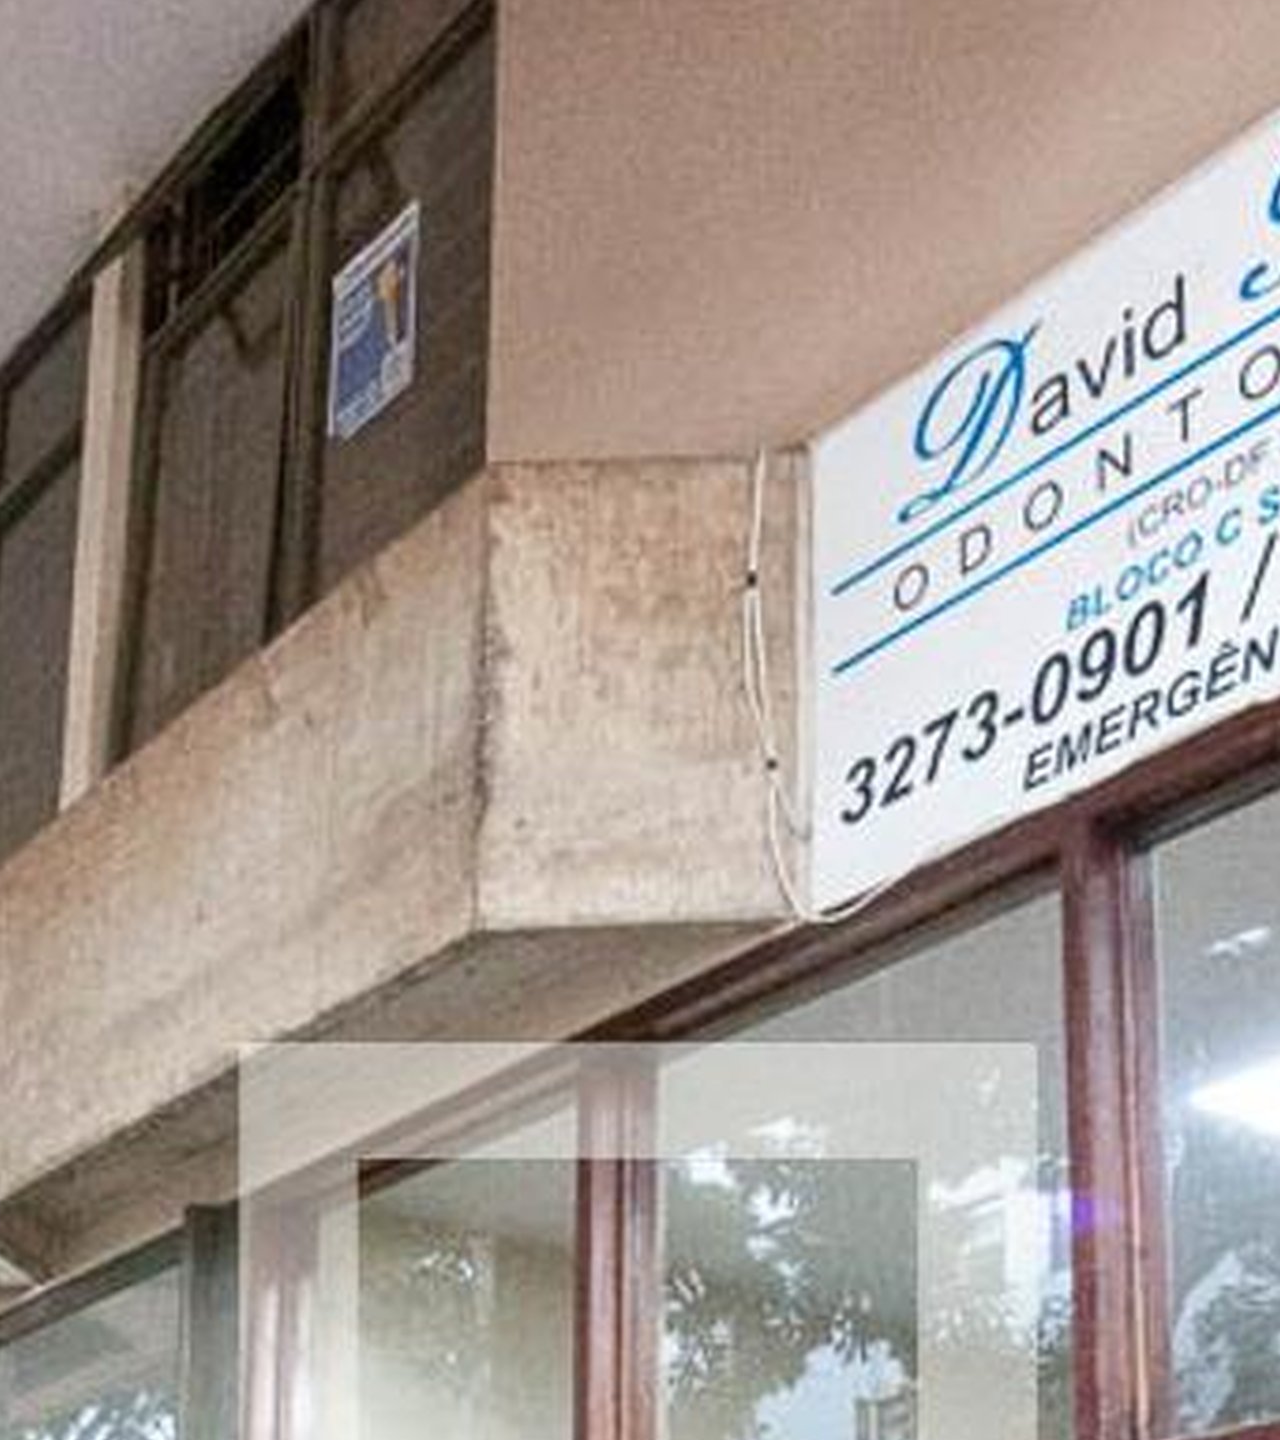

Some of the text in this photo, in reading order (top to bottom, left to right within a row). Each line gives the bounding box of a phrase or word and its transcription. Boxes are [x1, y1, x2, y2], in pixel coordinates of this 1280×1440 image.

[897, 274, 1191, 525] David
[1066, 531, 1204, 631] BLOCO
[1215, 507, 1243, 546] C
[839, 572, 1210, 825] 3273-0901
